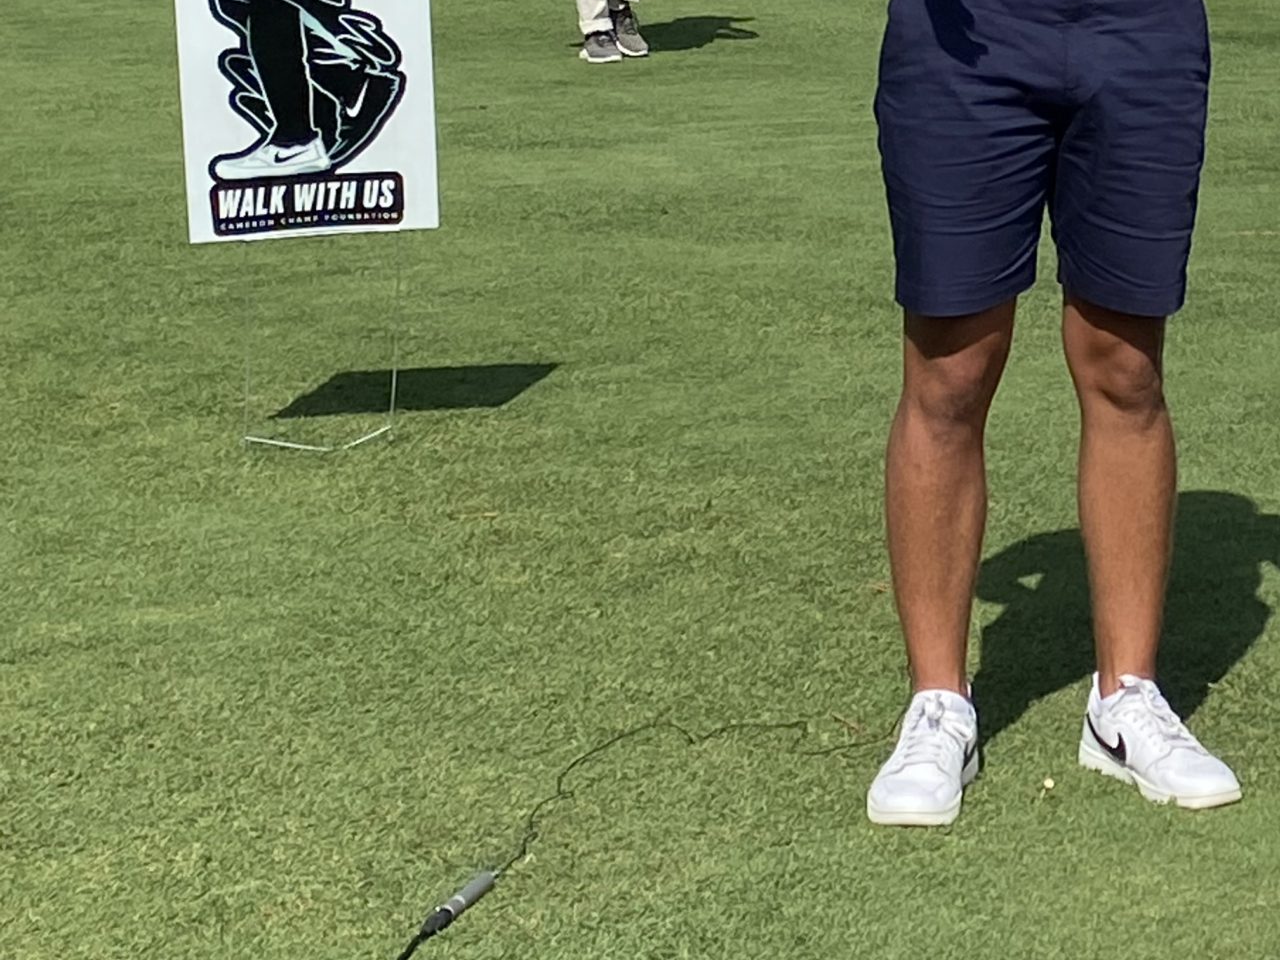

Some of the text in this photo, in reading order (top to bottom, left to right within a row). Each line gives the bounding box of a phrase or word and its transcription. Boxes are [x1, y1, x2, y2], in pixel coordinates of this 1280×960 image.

[218, 179, 395, 219] WALK WITH US
[220, 212, 399, 231] CAMERON CHAMP FOUNDATION
